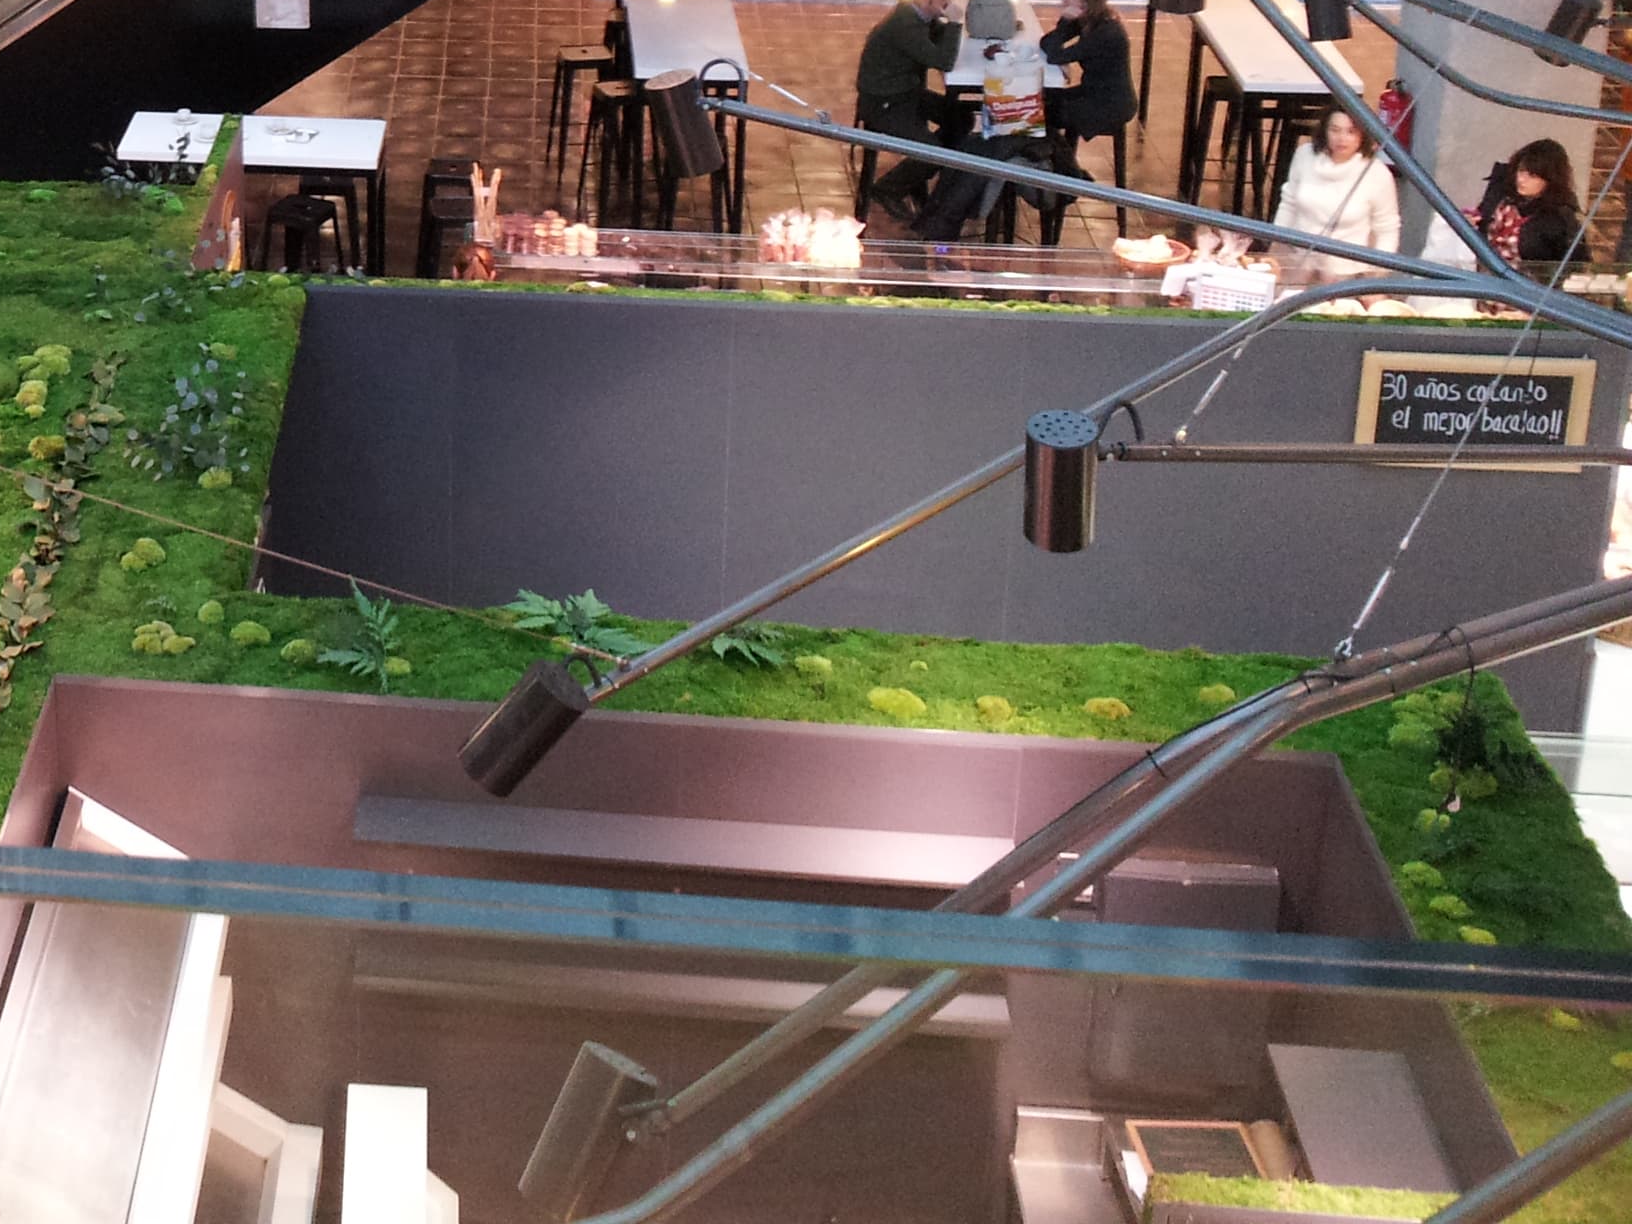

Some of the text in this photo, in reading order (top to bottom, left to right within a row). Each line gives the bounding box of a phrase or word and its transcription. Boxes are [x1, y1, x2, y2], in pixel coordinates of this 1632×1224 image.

[1382, 373, 1407, 400] 30
[1414, 378, 1462, 401] años
[1392, 406, 1411, 428] el
